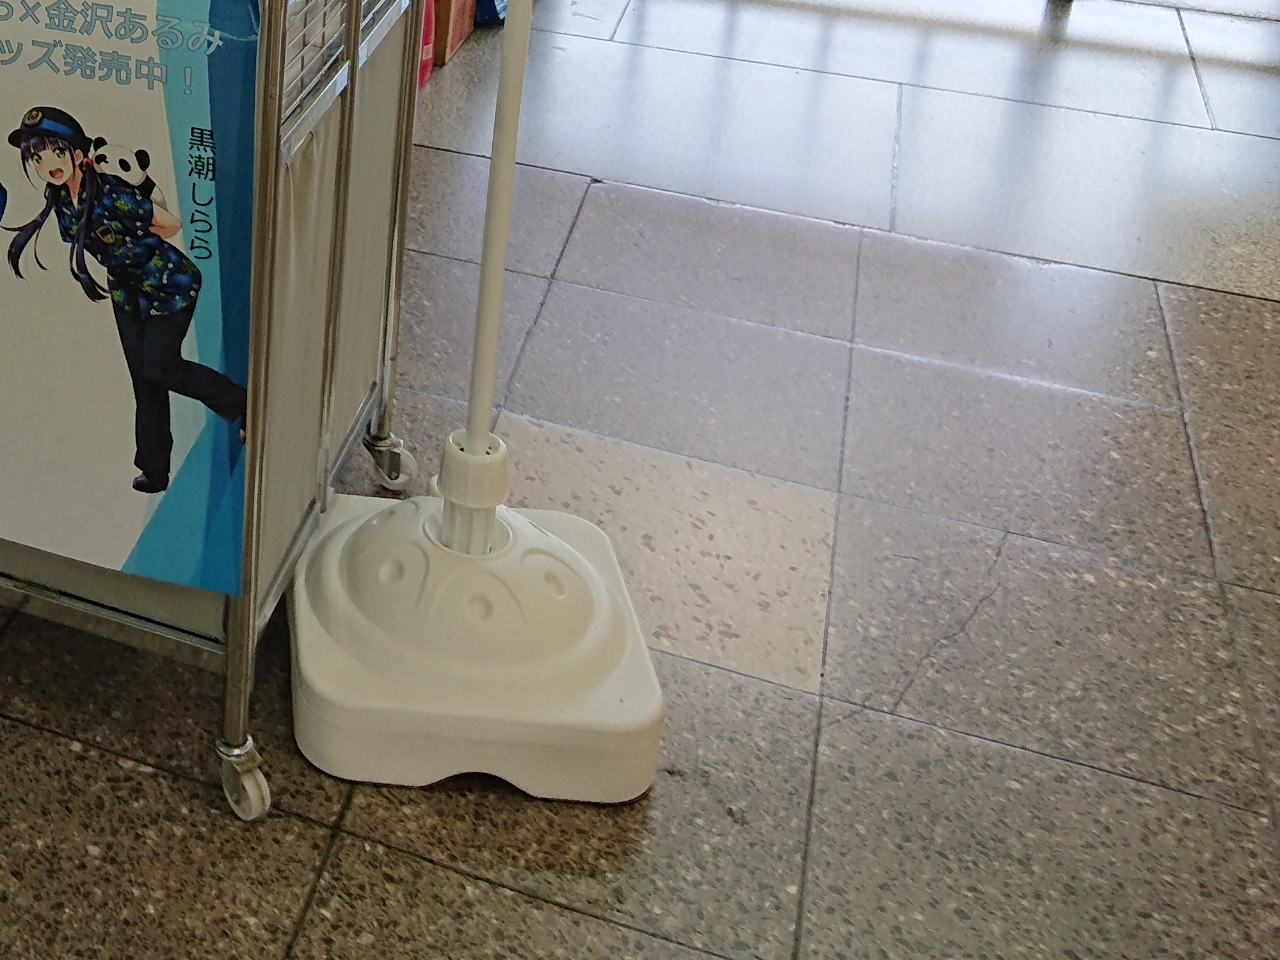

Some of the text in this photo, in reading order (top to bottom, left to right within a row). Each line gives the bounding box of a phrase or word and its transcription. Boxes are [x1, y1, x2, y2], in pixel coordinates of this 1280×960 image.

[188, 126, 216, 261] 黒潮しらら
